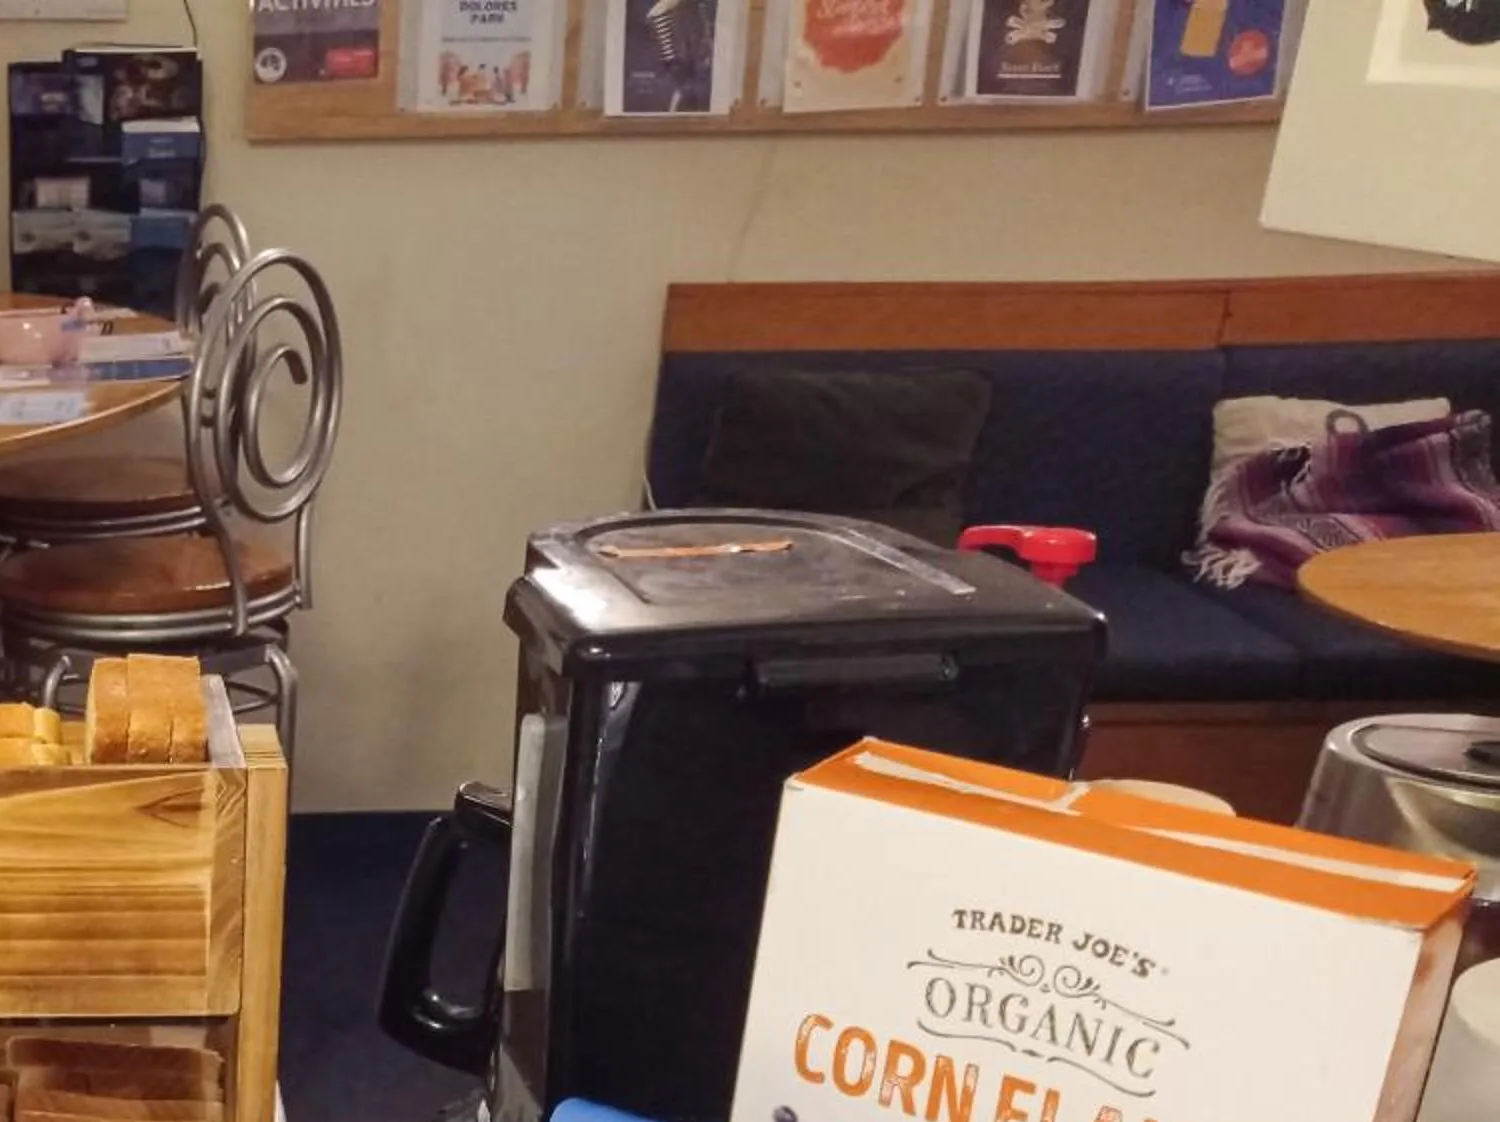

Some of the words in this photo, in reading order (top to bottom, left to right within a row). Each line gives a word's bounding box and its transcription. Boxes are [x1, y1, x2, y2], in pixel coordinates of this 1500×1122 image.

[952, 908, 1063, 944] TRADER
[1072, 931, 1157, 978] JOE'S
[924, 975, 1161, 1079] ORGANIC
